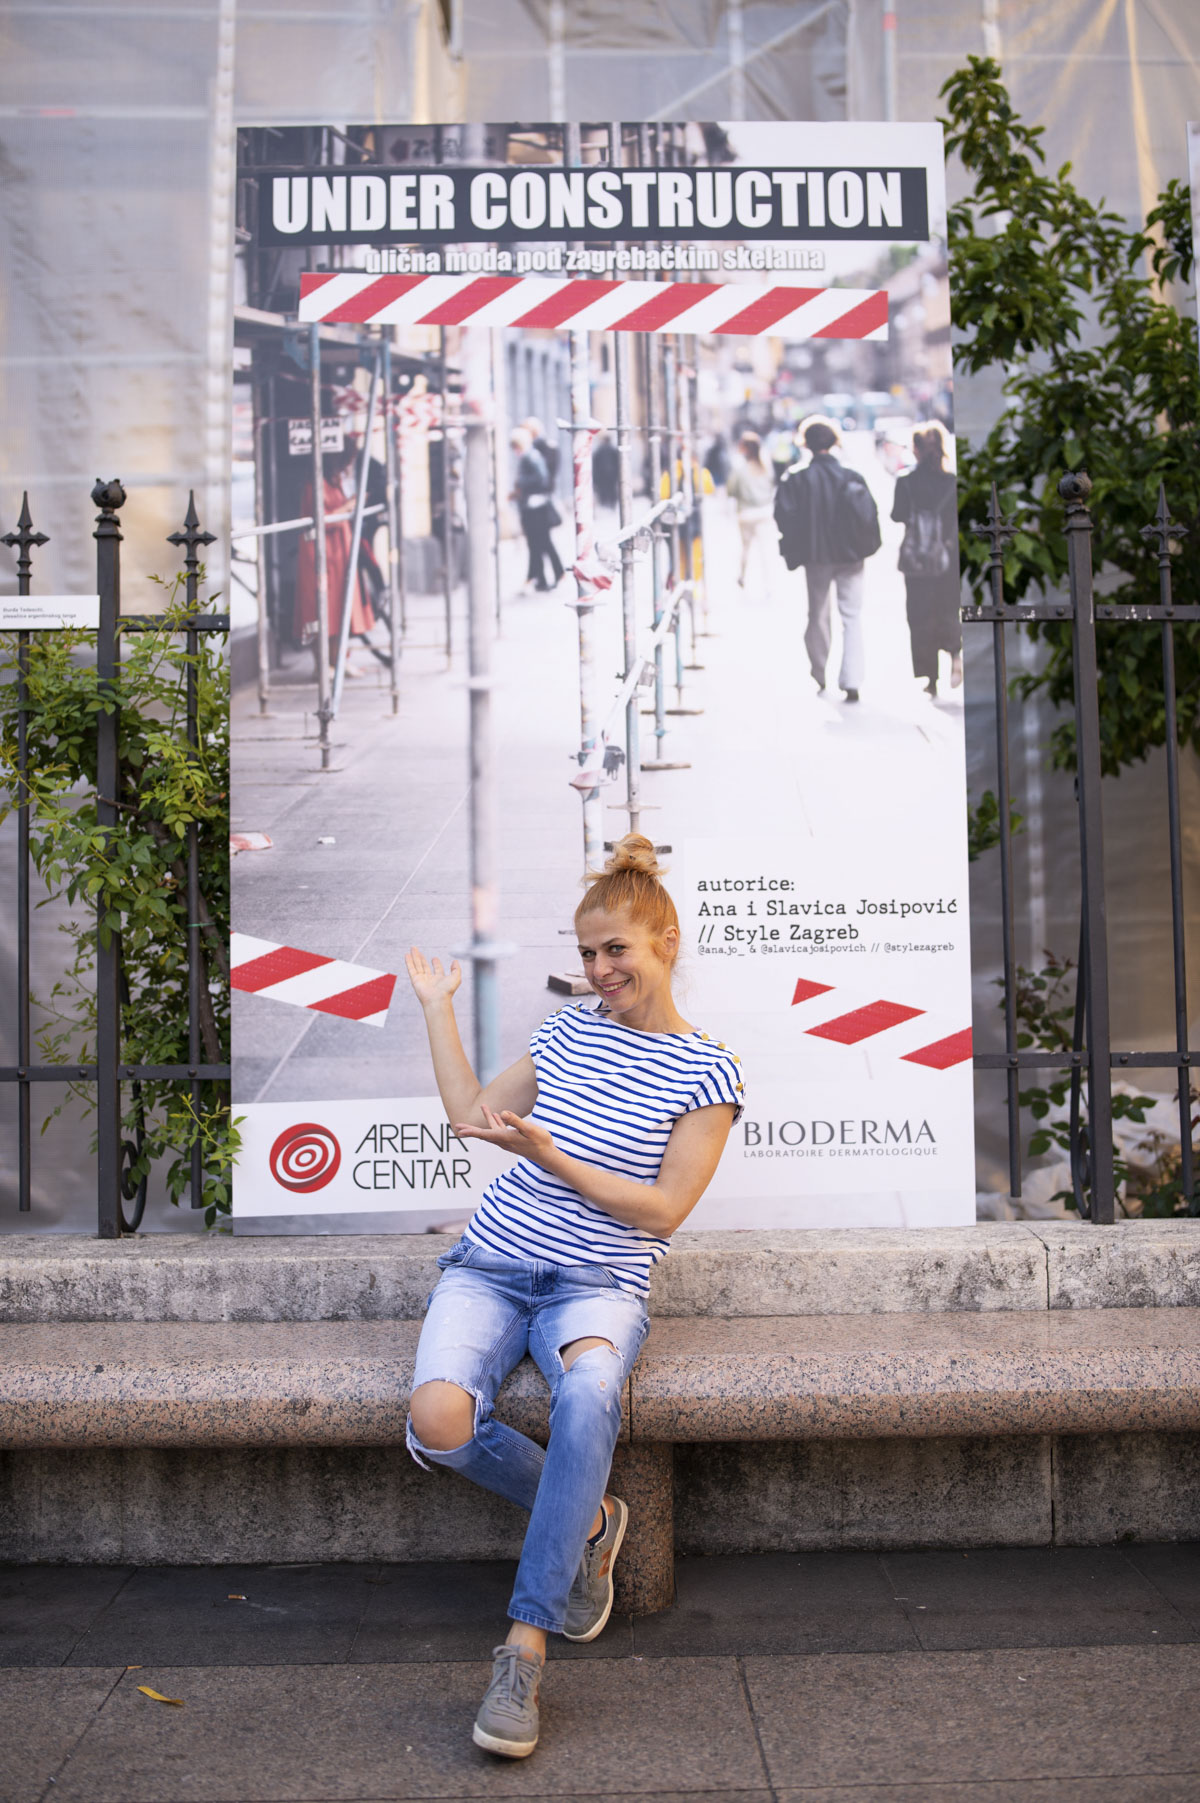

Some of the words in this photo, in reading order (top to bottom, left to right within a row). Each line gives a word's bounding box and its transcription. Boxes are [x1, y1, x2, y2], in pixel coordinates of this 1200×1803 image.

[272, 174, 456, 234] UNDER
[469, 171, 903, 231] CONSTRUCTION
[365, 247, 442, 274] ulična
[444, 248, 513, 273] moda
[516, 248, 562, 274] pod
[565, 246, 720, 274] zagrebačkim
[723, 245, 825, 271] skelama
[697, 876, 795, 892] autorice:
[697, 901, 738, 917] Ana
[746, 901, 758, 916] i
[766, 899, 847, 916] Slavica
[856, 898, 959, 918] Josipović
[698, 924, 716, 944] //
[724, 925, 781, 945] Style
[789, 924, 860, 944] Zagreb
[749, 944, 757, 954] &
[760, 943, 867, 955] @slavicajosipovich
[870, 943, 880, 953] //
[883, 942, 955, 953] @stylezagreb
[354, 1123, 470, 1154] ARENA
[743, 1119, 937, 1146] BIODERMA
[743, 1149, 825, 1158] LABORATOIRE
[829, 1147, 939, 1157] DERMATOLOGIQUE
[352, 1158, 472, 1190] CENTAR
